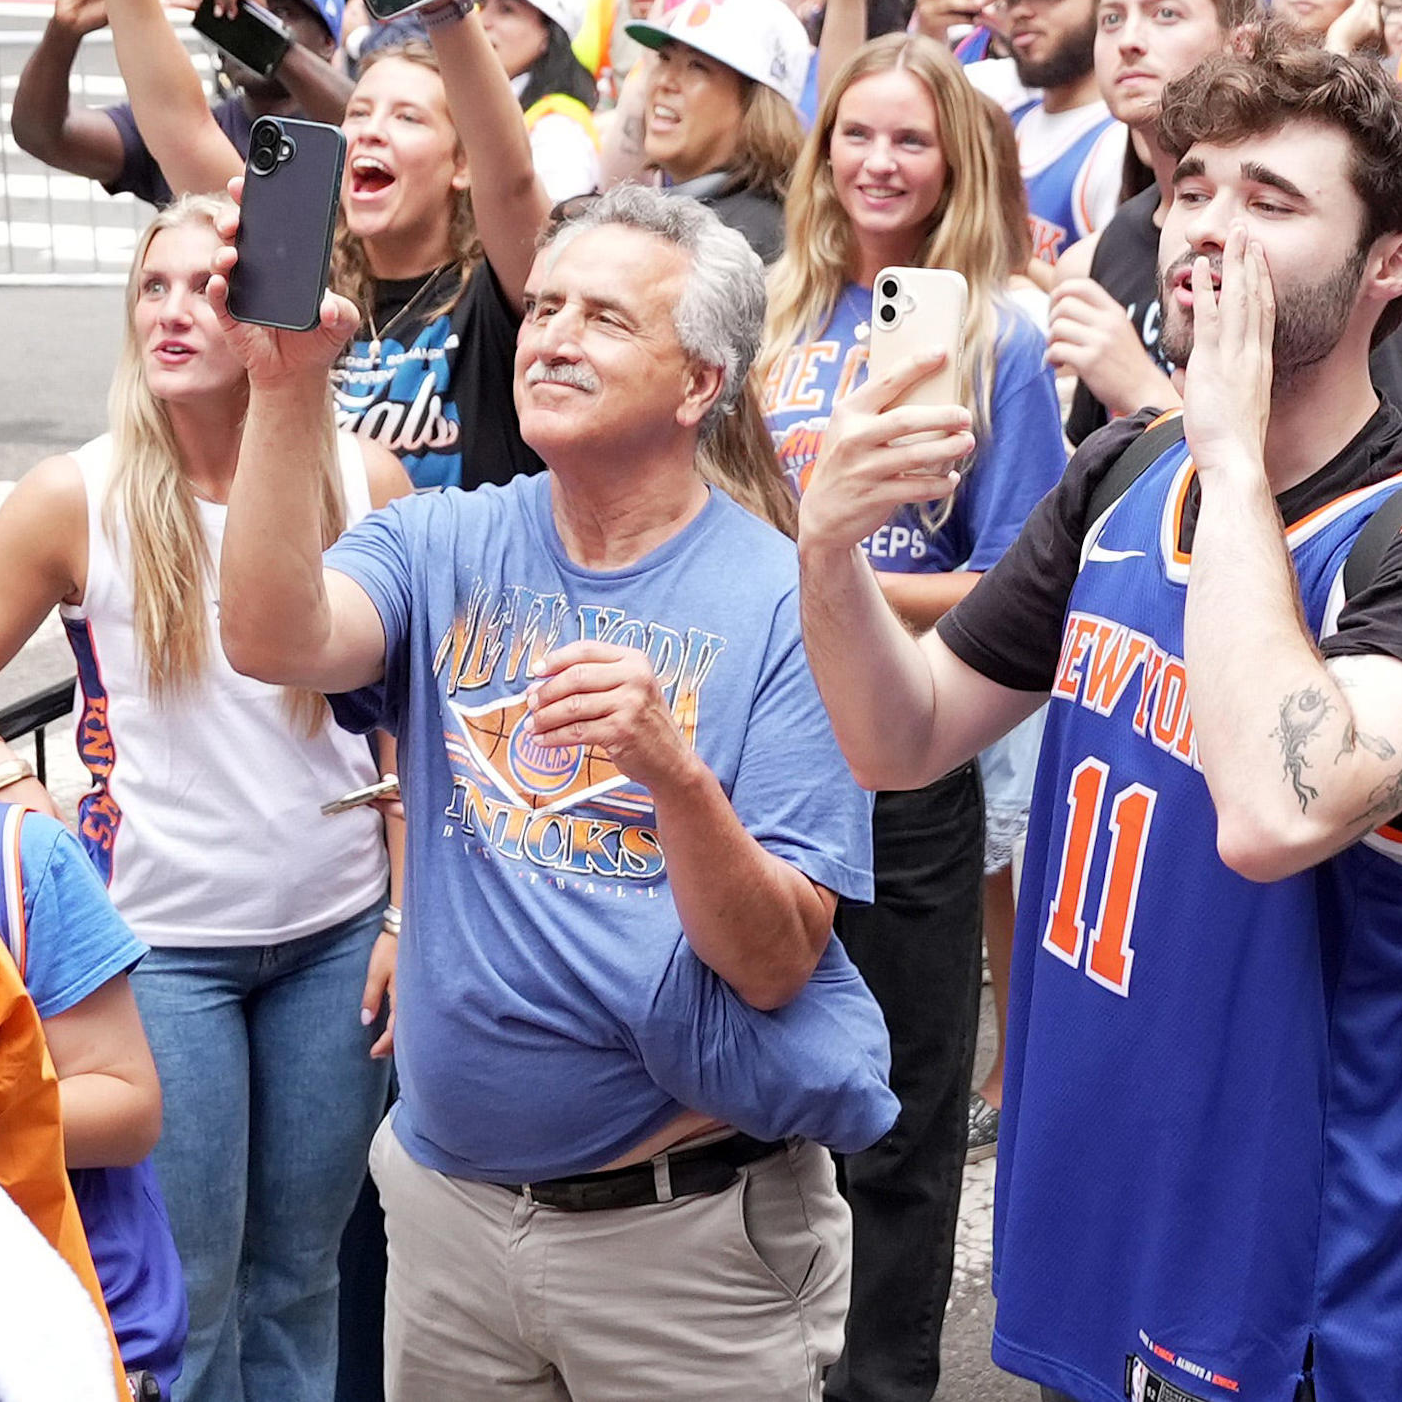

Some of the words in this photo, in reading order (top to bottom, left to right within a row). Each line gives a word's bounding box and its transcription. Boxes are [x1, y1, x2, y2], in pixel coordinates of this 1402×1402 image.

[760, 340, 841, 416] HE
[432, 575, 572, 697] NEW
[1051, 610, 1147, 719] EW
[1132, 636, 1206, 775] YO
[82, 696, 118, 850] KNIKS
[1041, 755, 1159, 999] 11
